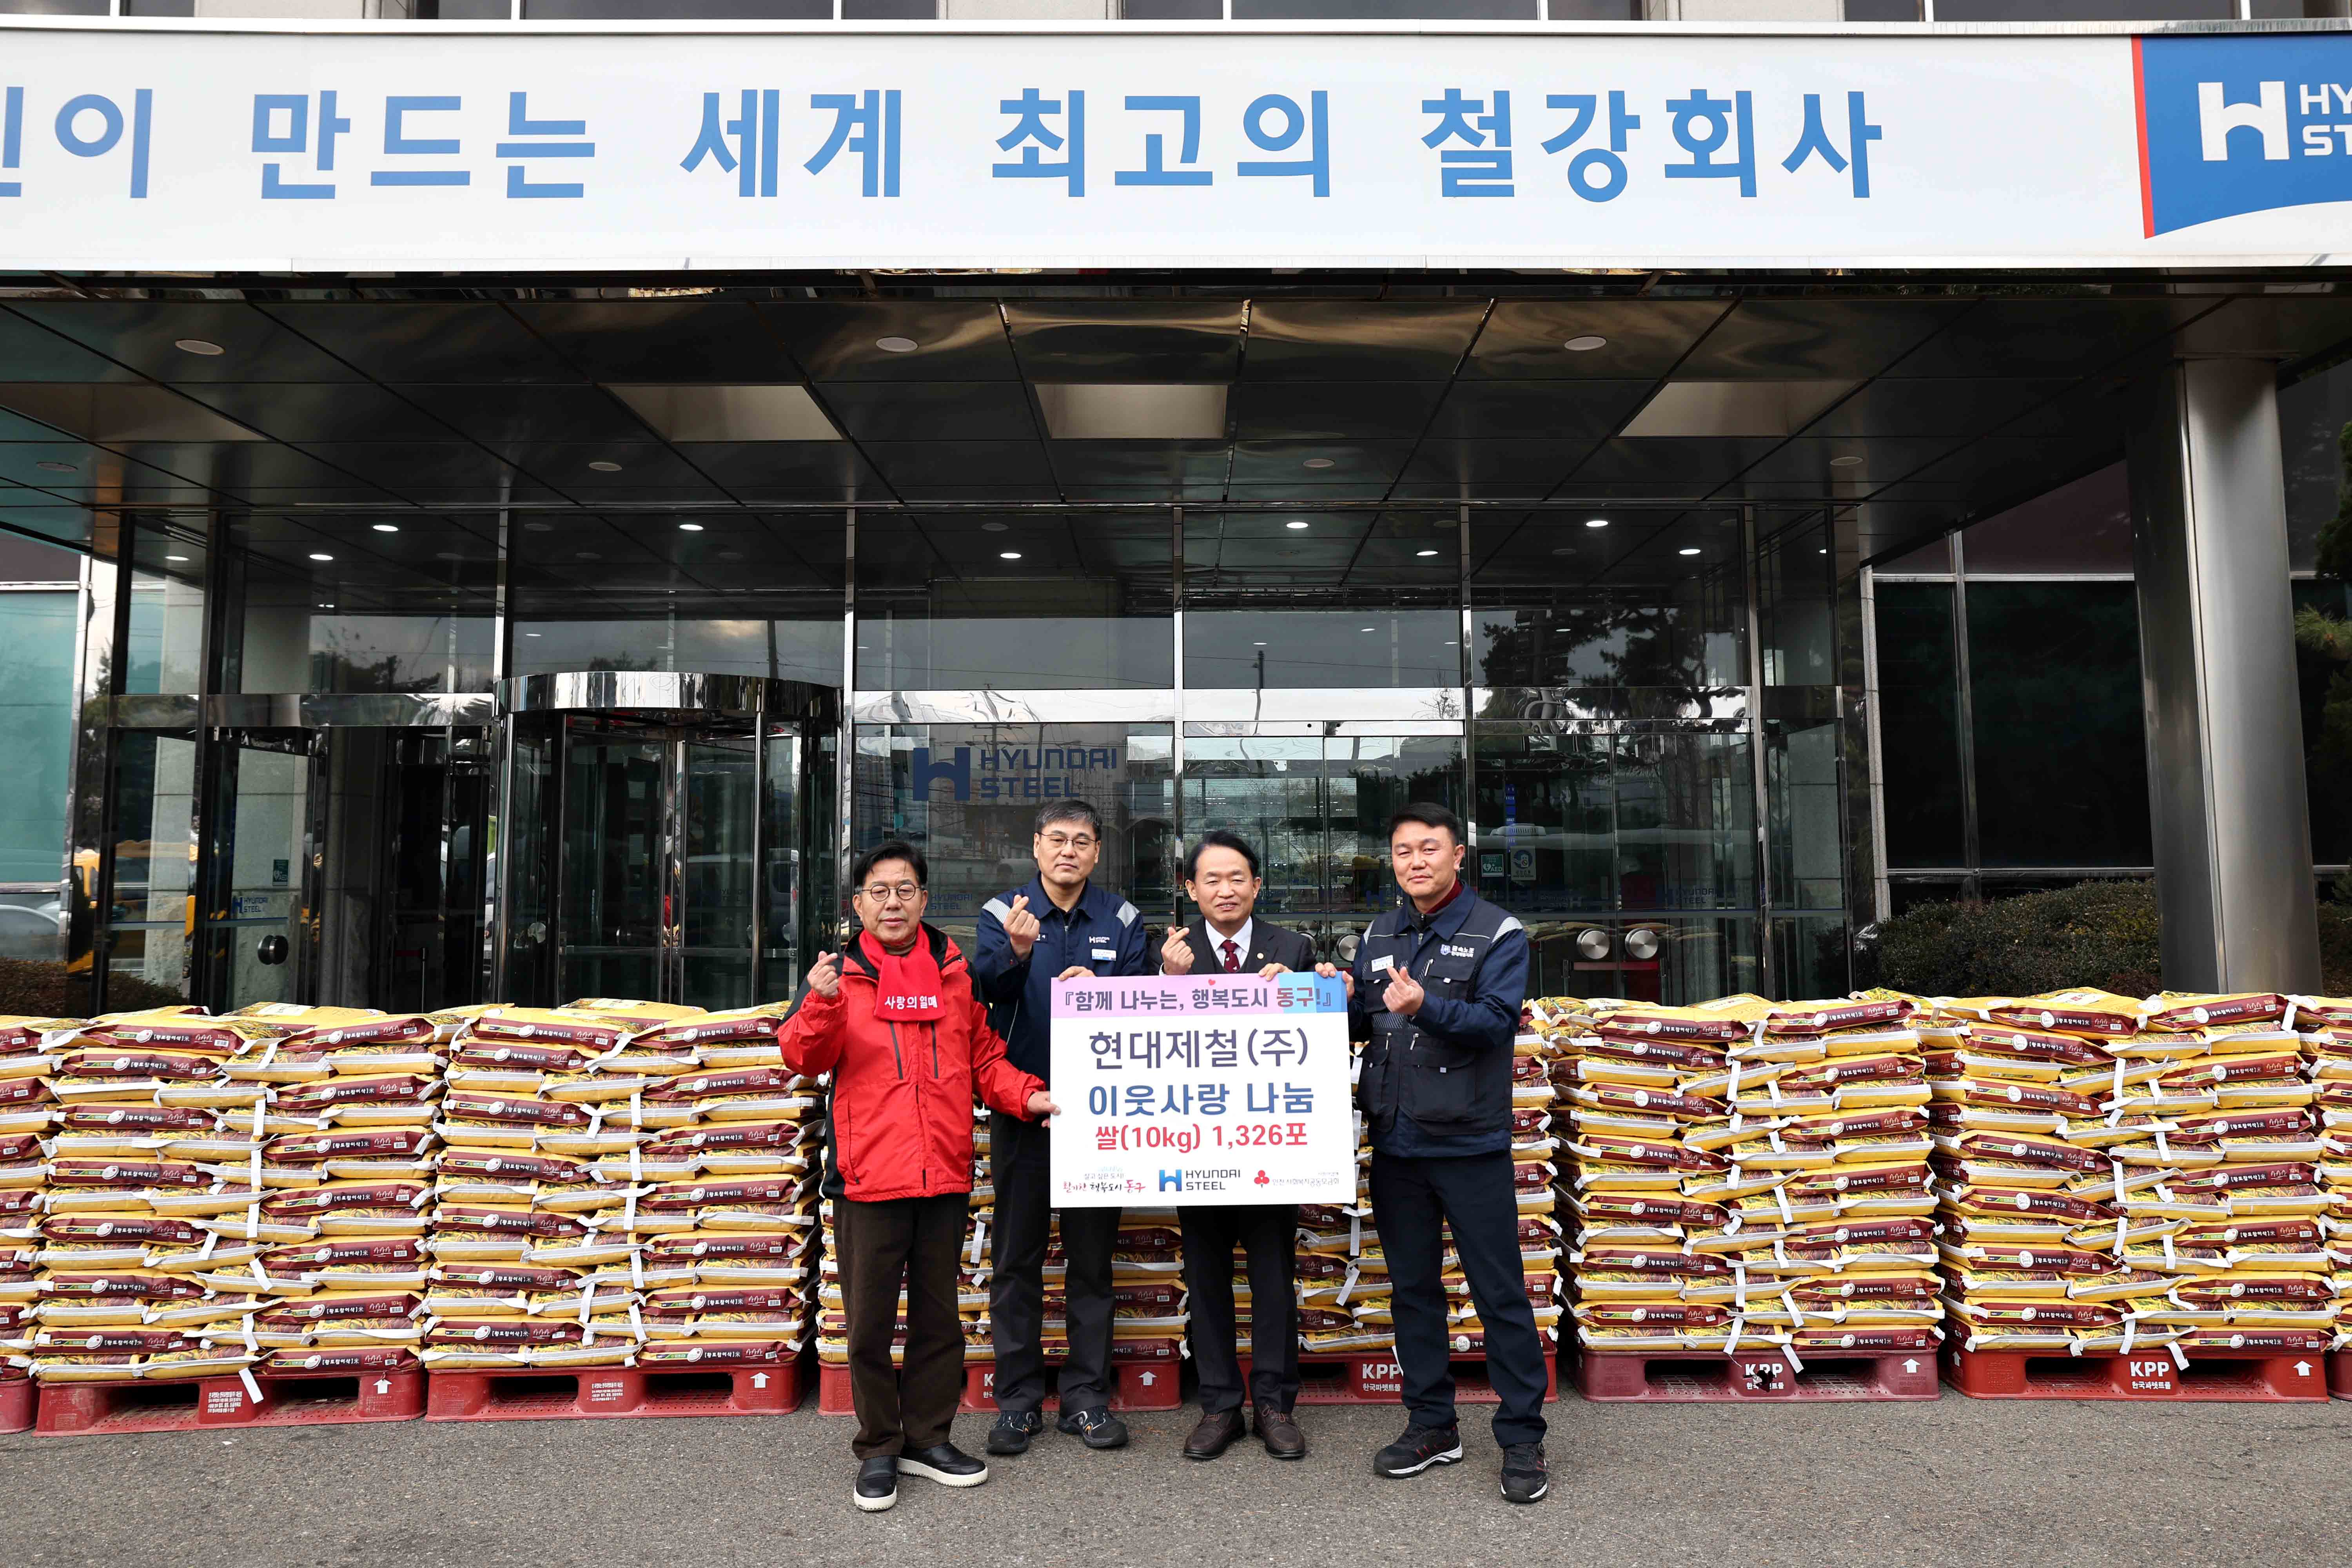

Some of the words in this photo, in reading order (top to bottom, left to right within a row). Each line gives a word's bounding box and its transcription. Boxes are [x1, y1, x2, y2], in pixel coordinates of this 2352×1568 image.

[251, 90, 595, 199] 만드는
[680, 89, 902, 197] 세계
[992, 88, 1330, 197] 최고의
[1420, 88, 1882, 203] 철강회사
[981, 748, 1117, 770] HYUNDAI
[981, 777, 1080, 798] STEEL
[884, 996, 917, 1010] 사랑의
[920, 995, 938, 1009] 열매
[1064, 989, 1112, 1011] 『함께
[1121, 989, 1184, 1011] 나누는,
[1192, 987, 1268, 1011] 행복도시
[1276, 986, 1331, 1009] 동구!』
[1089, 1027, 1308, 1070] 현대제철(주)
[1089, 1083, 1231, 1117] 이웃사랑
[1248, 1082, 1314, 1114] 나눔
[1095, 1123, 1201, 1153] 쌀(10kg)
[1213, 1122, 1308, 1149] 1,326포
[1186, 1169, 1241, 1179] HYUNDAI
[1090, 1181, 1122, 1193] 행복도시
[1123, 1180, 1146, 1193] 동구
[1186, 1180, 1226, 1191] STEEL
[1362, 1364, 1401, 1379] KPP
[2130, 1361, 2170, 1377] KPP
